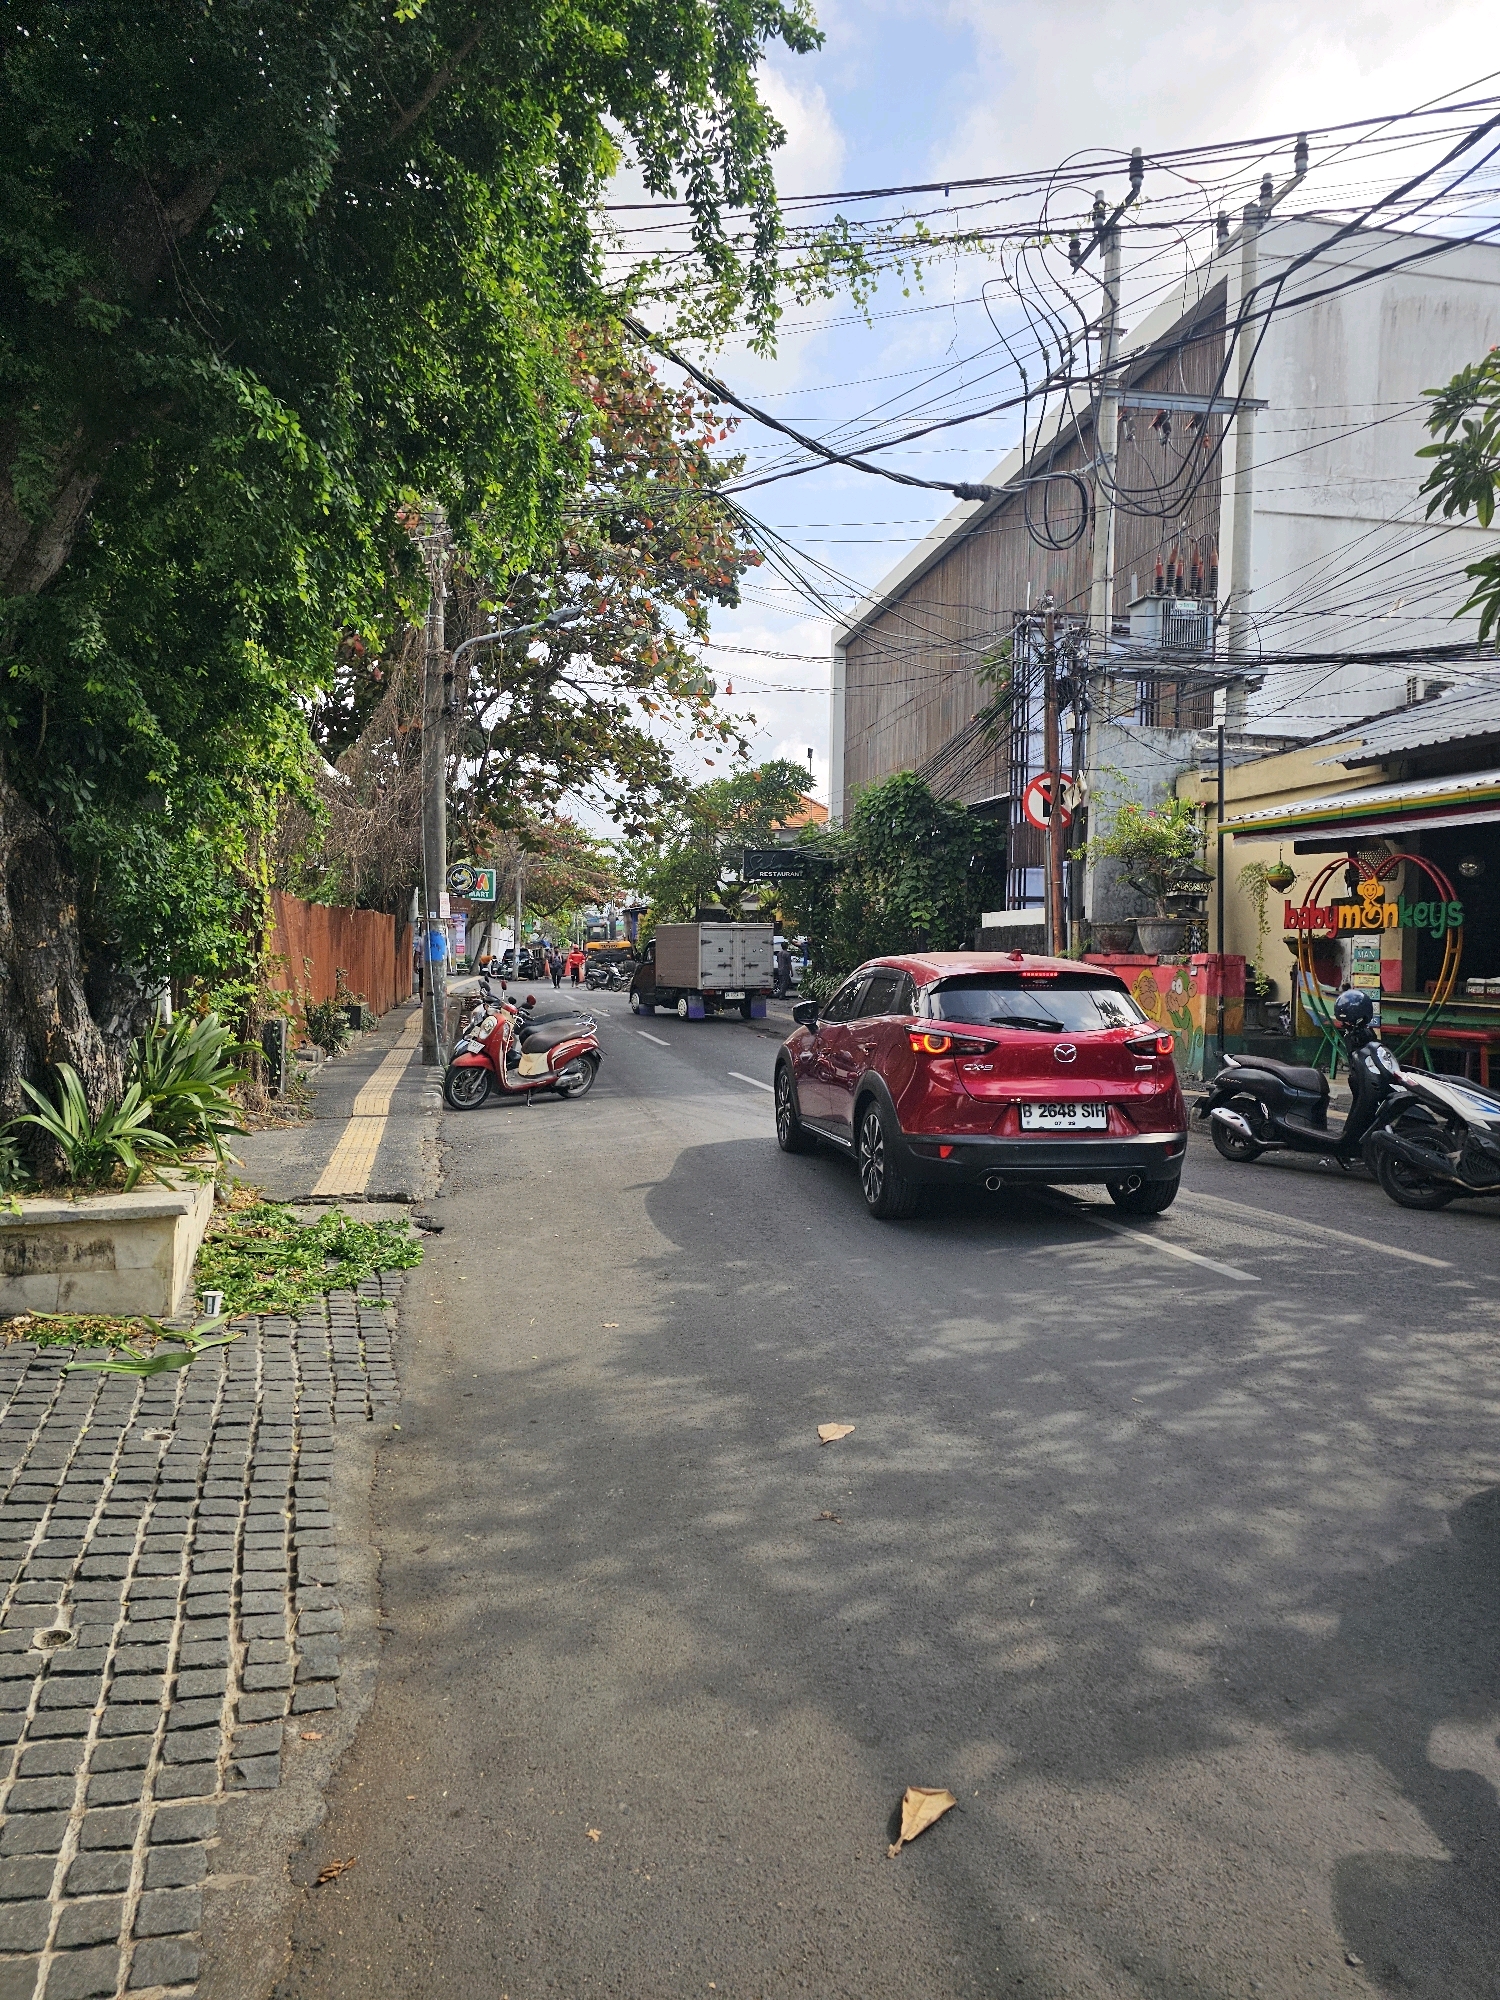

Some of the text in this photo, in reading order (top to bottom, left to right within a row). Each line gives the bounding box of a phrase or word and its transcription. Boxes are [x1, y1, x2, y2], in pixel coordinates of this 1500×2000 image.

[1357, 950, 1376, 959] MAN
[1022, 1103, 1105, 1118] B 2648 SIH
